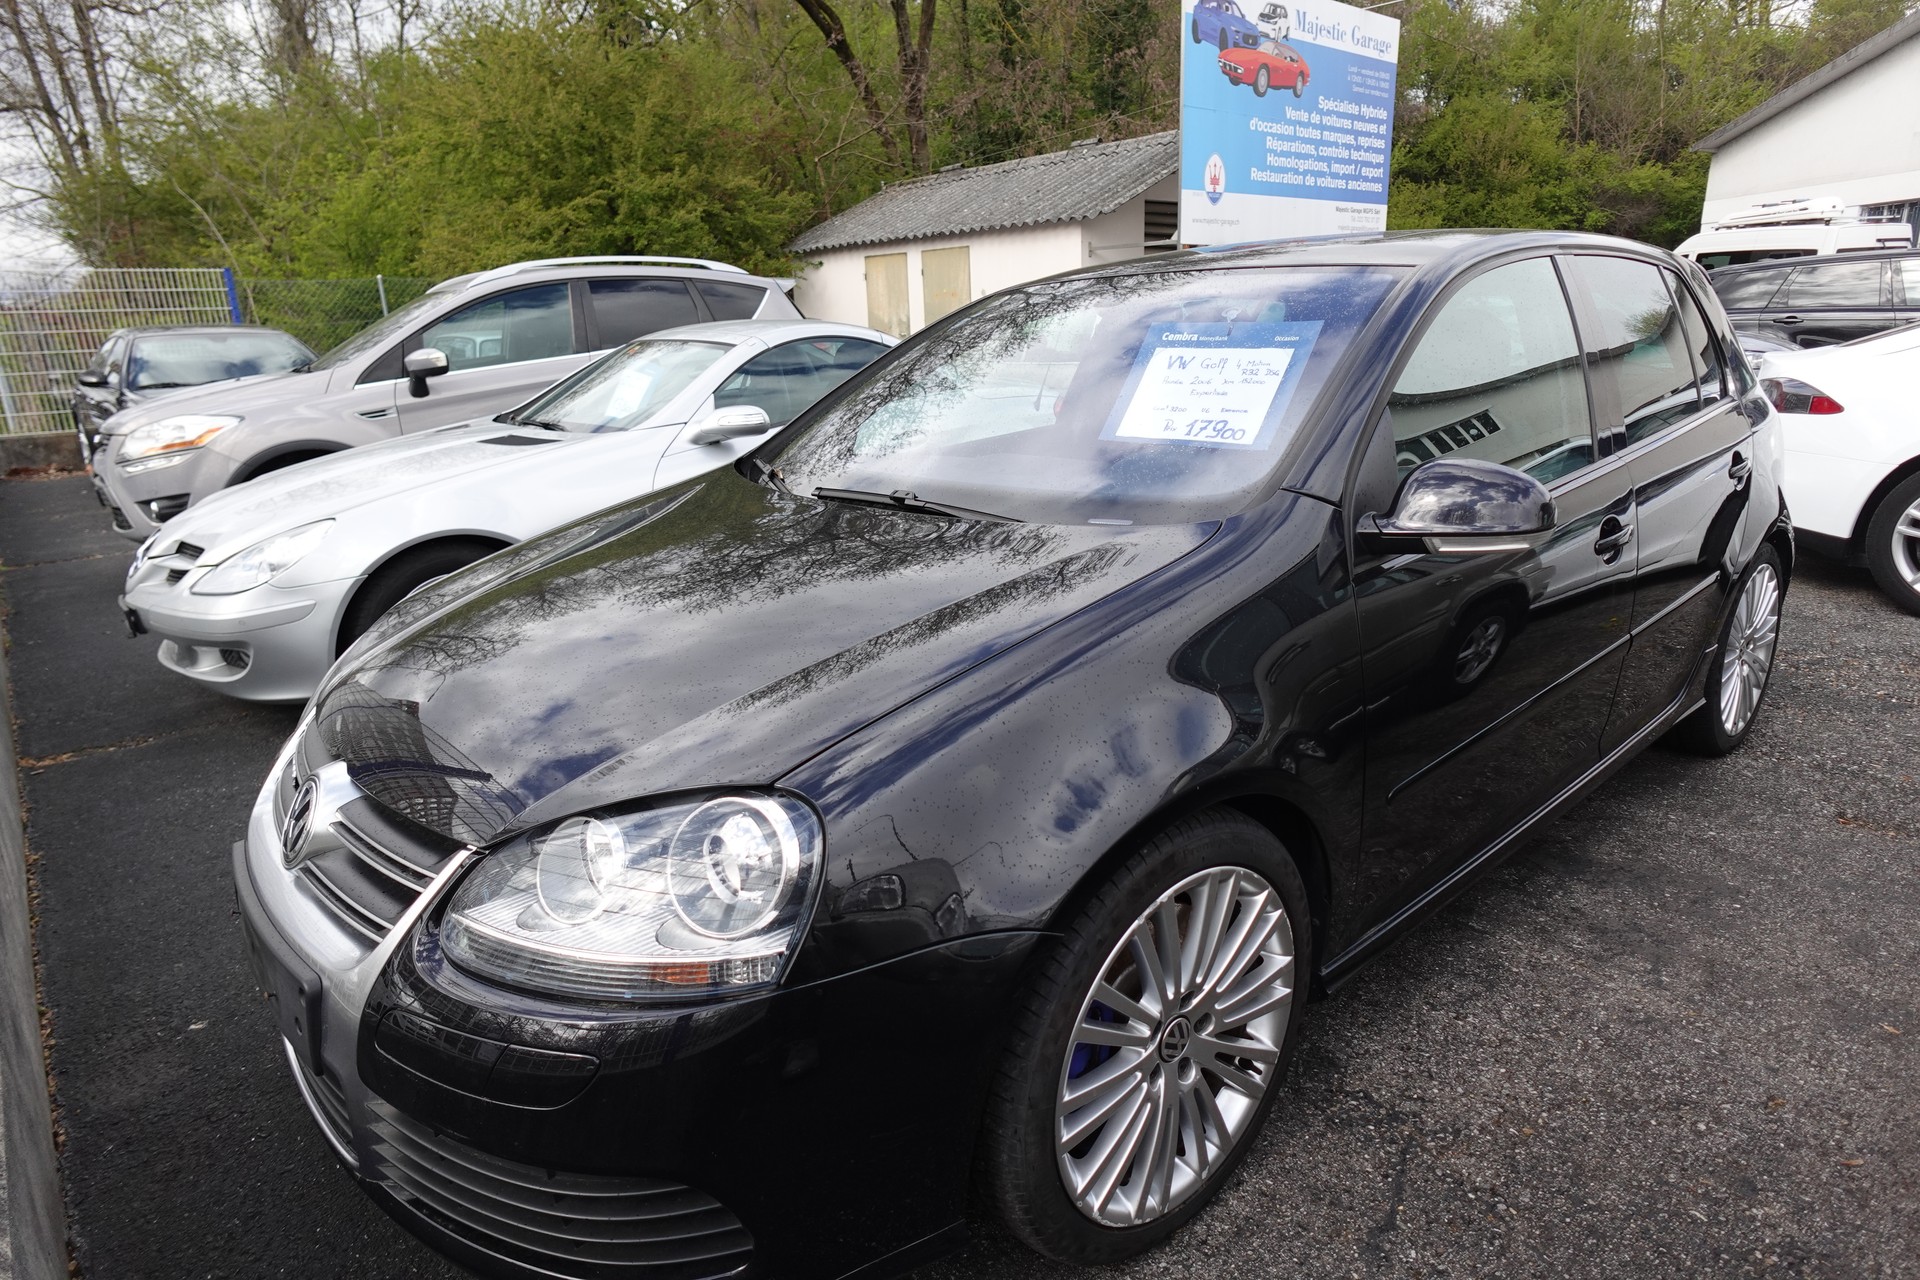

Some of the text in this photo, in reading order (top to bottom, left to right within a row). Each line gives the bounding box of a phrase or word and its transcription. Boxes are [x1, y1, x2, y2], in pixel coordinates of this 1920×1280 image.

[1295, 9, 1392, 58] Majestic Garage
[1285, 106, 1387, 134] Vente de voitures neuves et
[1318, 96, 1388, 120] Spécialiste Hybride
[1250, 117, 1385, 149] d'occasion toutes marques, reprises
[1266, 136, 1385, 165] Réparations, contrôle technique
[1267, 153, 1384, 179] Homologations, import / export
[1250, 167, 1383, 193] Restauration de voitures anciennes
[1162, 332, 1198, 341] Cembra
[1167, 355, 1196, 370] VW
[1200, 357, 1228, 375] Golf
[1241, 368, 1260, 376] R32
